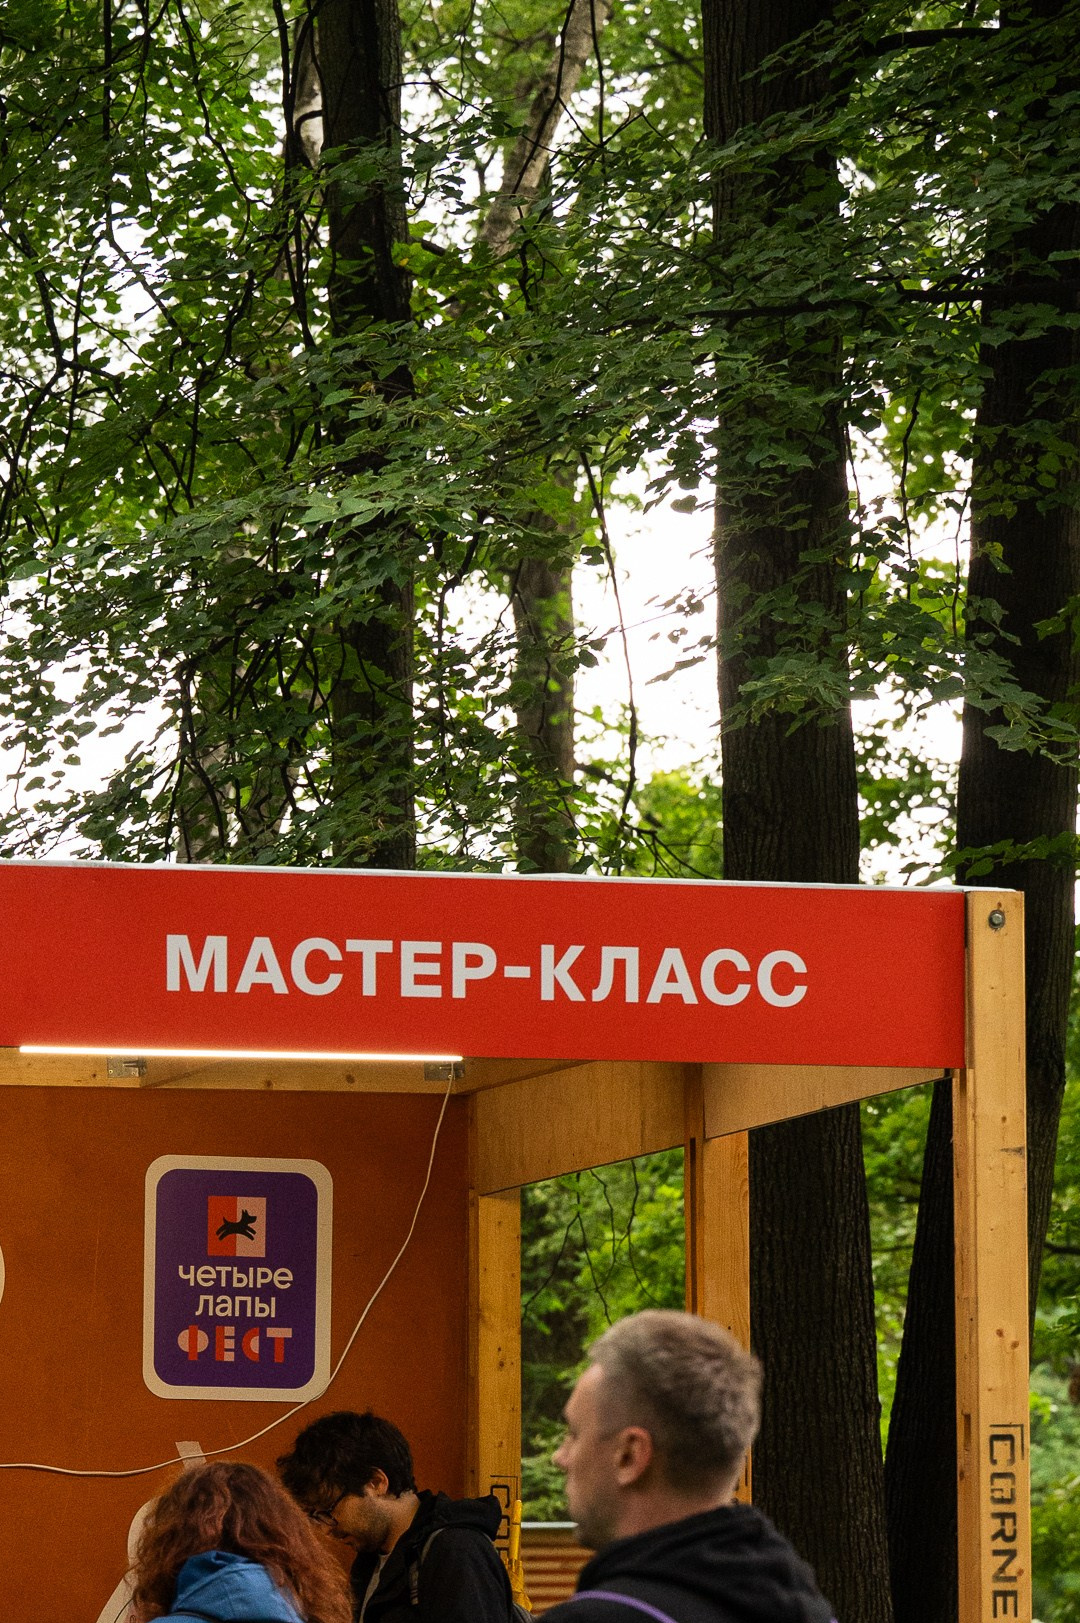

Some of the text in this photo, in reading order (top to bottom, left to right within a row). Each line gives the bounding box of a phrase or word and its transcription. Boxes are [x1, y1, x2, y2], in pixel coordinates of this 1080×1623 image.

[165, 934, 809, 1008] МАСТЕР-КЛАСС
[178, 1265, 293, 1289] четыре
[195, 1295, 276, 1318] лапы
[177, 1325, 292, 1363] ФЕСТ
